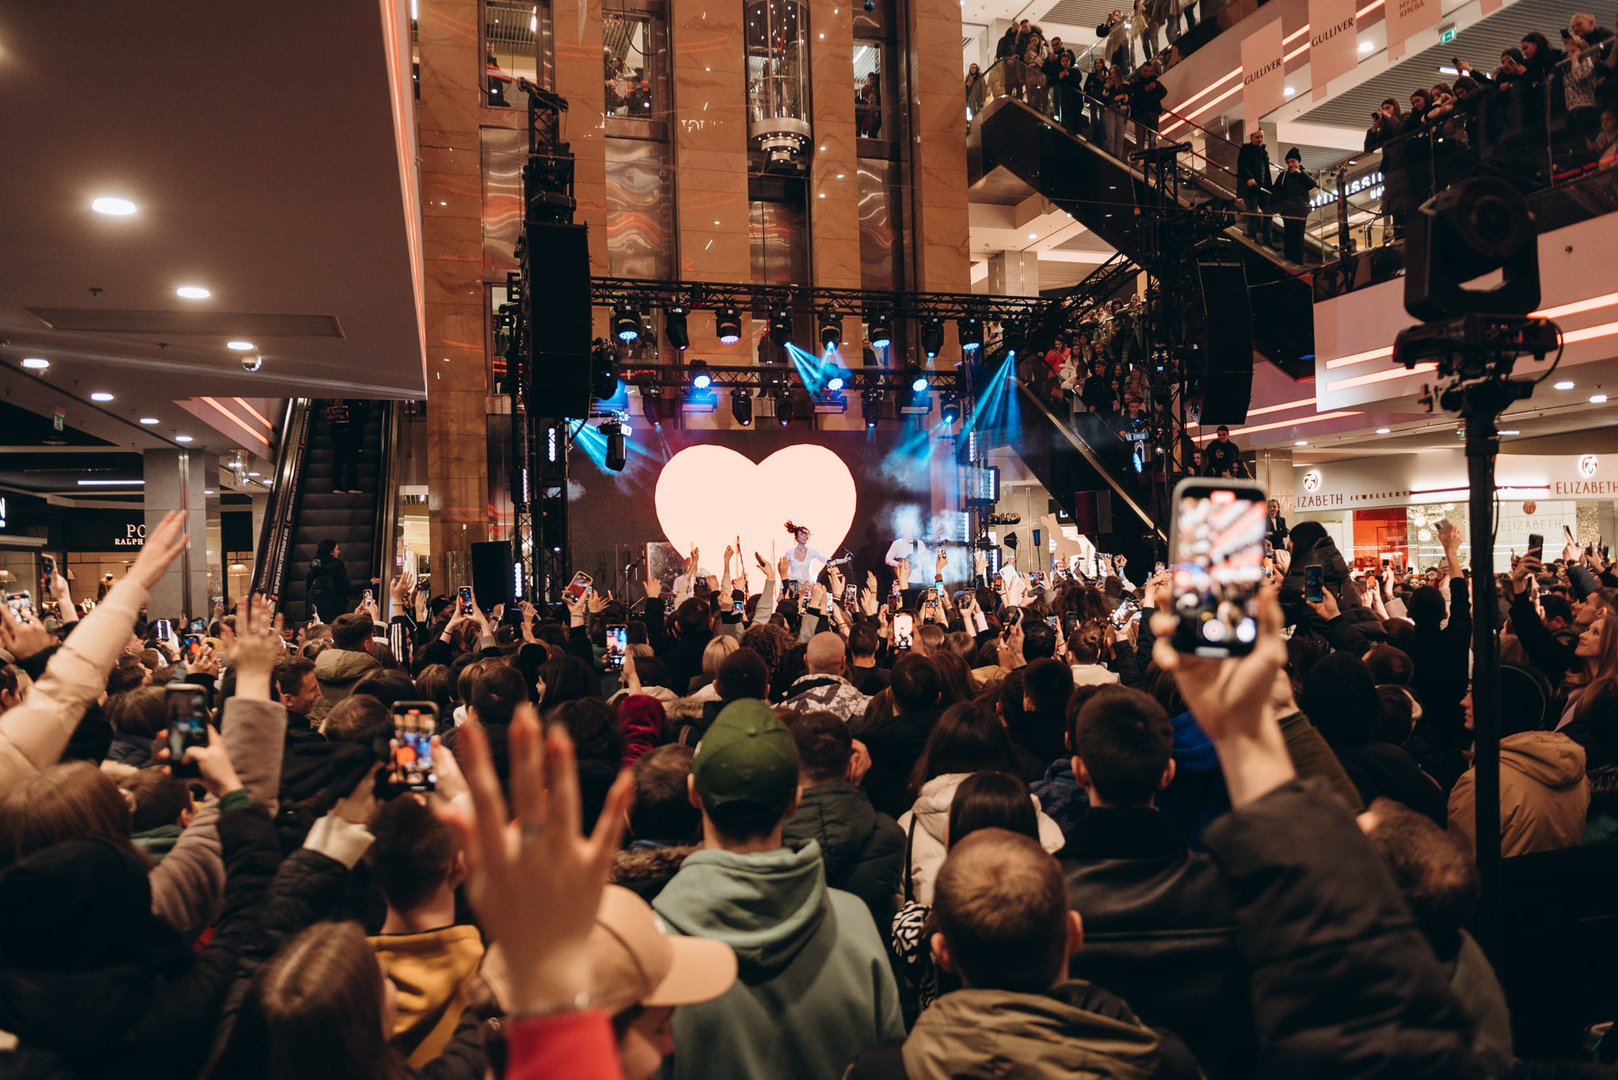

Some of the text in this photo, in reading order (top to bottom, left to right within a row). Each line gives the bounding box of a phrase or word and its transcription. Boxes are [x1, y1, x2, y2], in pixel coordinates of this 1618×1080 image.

[1399, 0, 1425, 18] КИЄВА
[1311, 17, 1354, 47] GULLIVER
[1244, 58, 1282, 85] GULLIVER
[1556, 481, 1618, 494] ELIZABETH
[1294, 490, 1407, 508] IZABETH JEWELLERY
[126, 523, 146, 538] PO
[1501, 519, 1561, 531] ELIZABETH
[114, 538, 144, 546] RALPH
